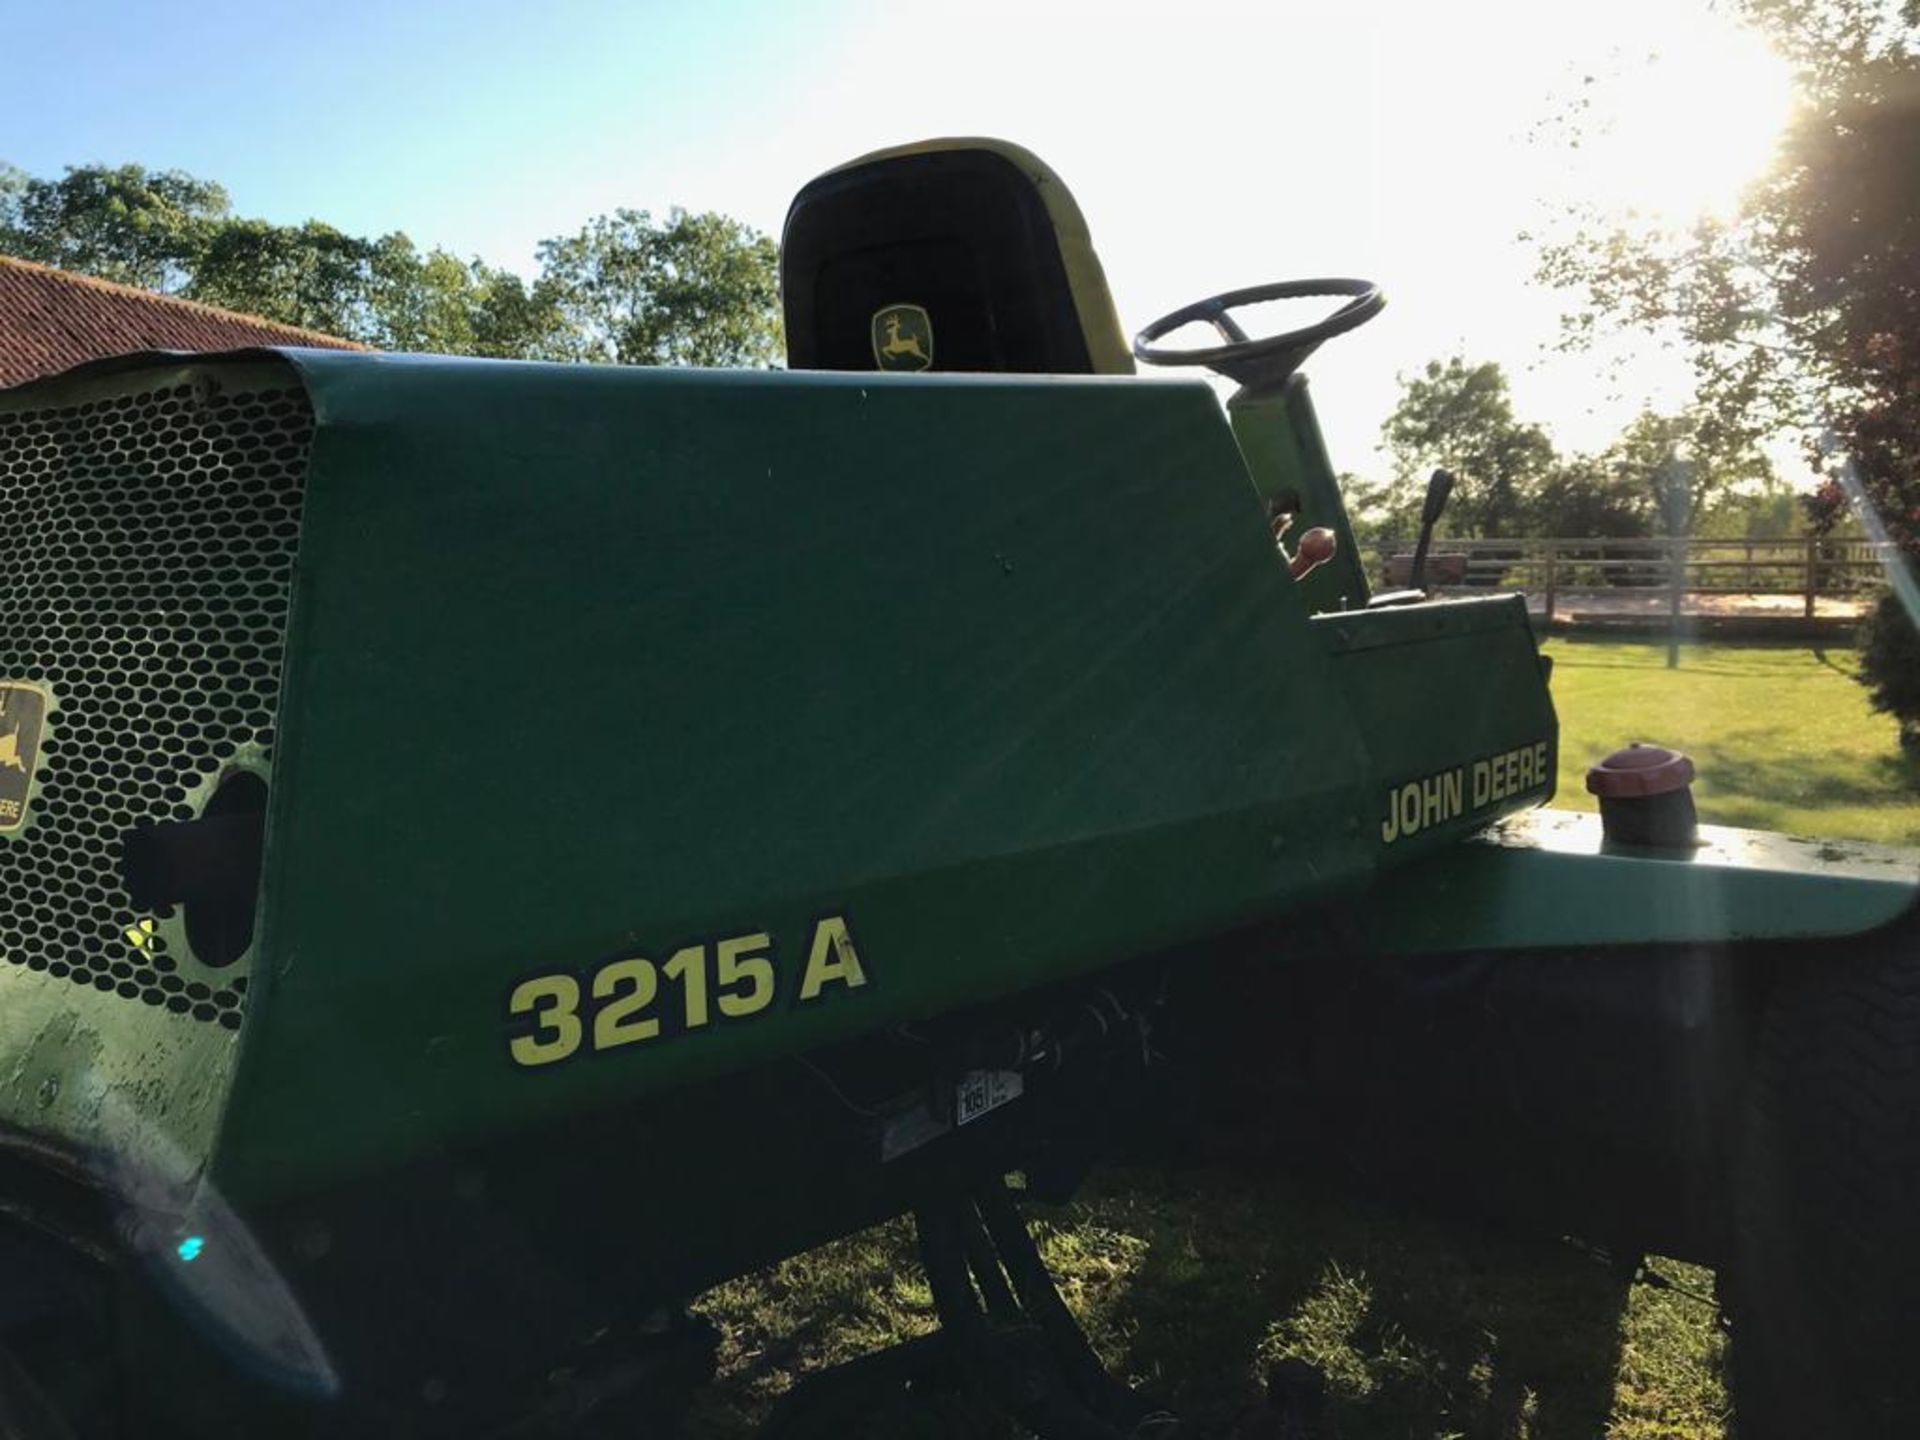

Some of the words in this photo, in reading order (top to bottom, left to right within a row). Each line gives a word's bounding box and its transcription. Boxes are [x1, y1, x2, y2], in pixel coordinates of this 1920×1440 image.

[1382, 768, 1463, 843] JOHN
[1473, 743, 1547, 809] DEERE
[509, 931, 775, 1067] 3215
[799, 916, 868, 1000] A
